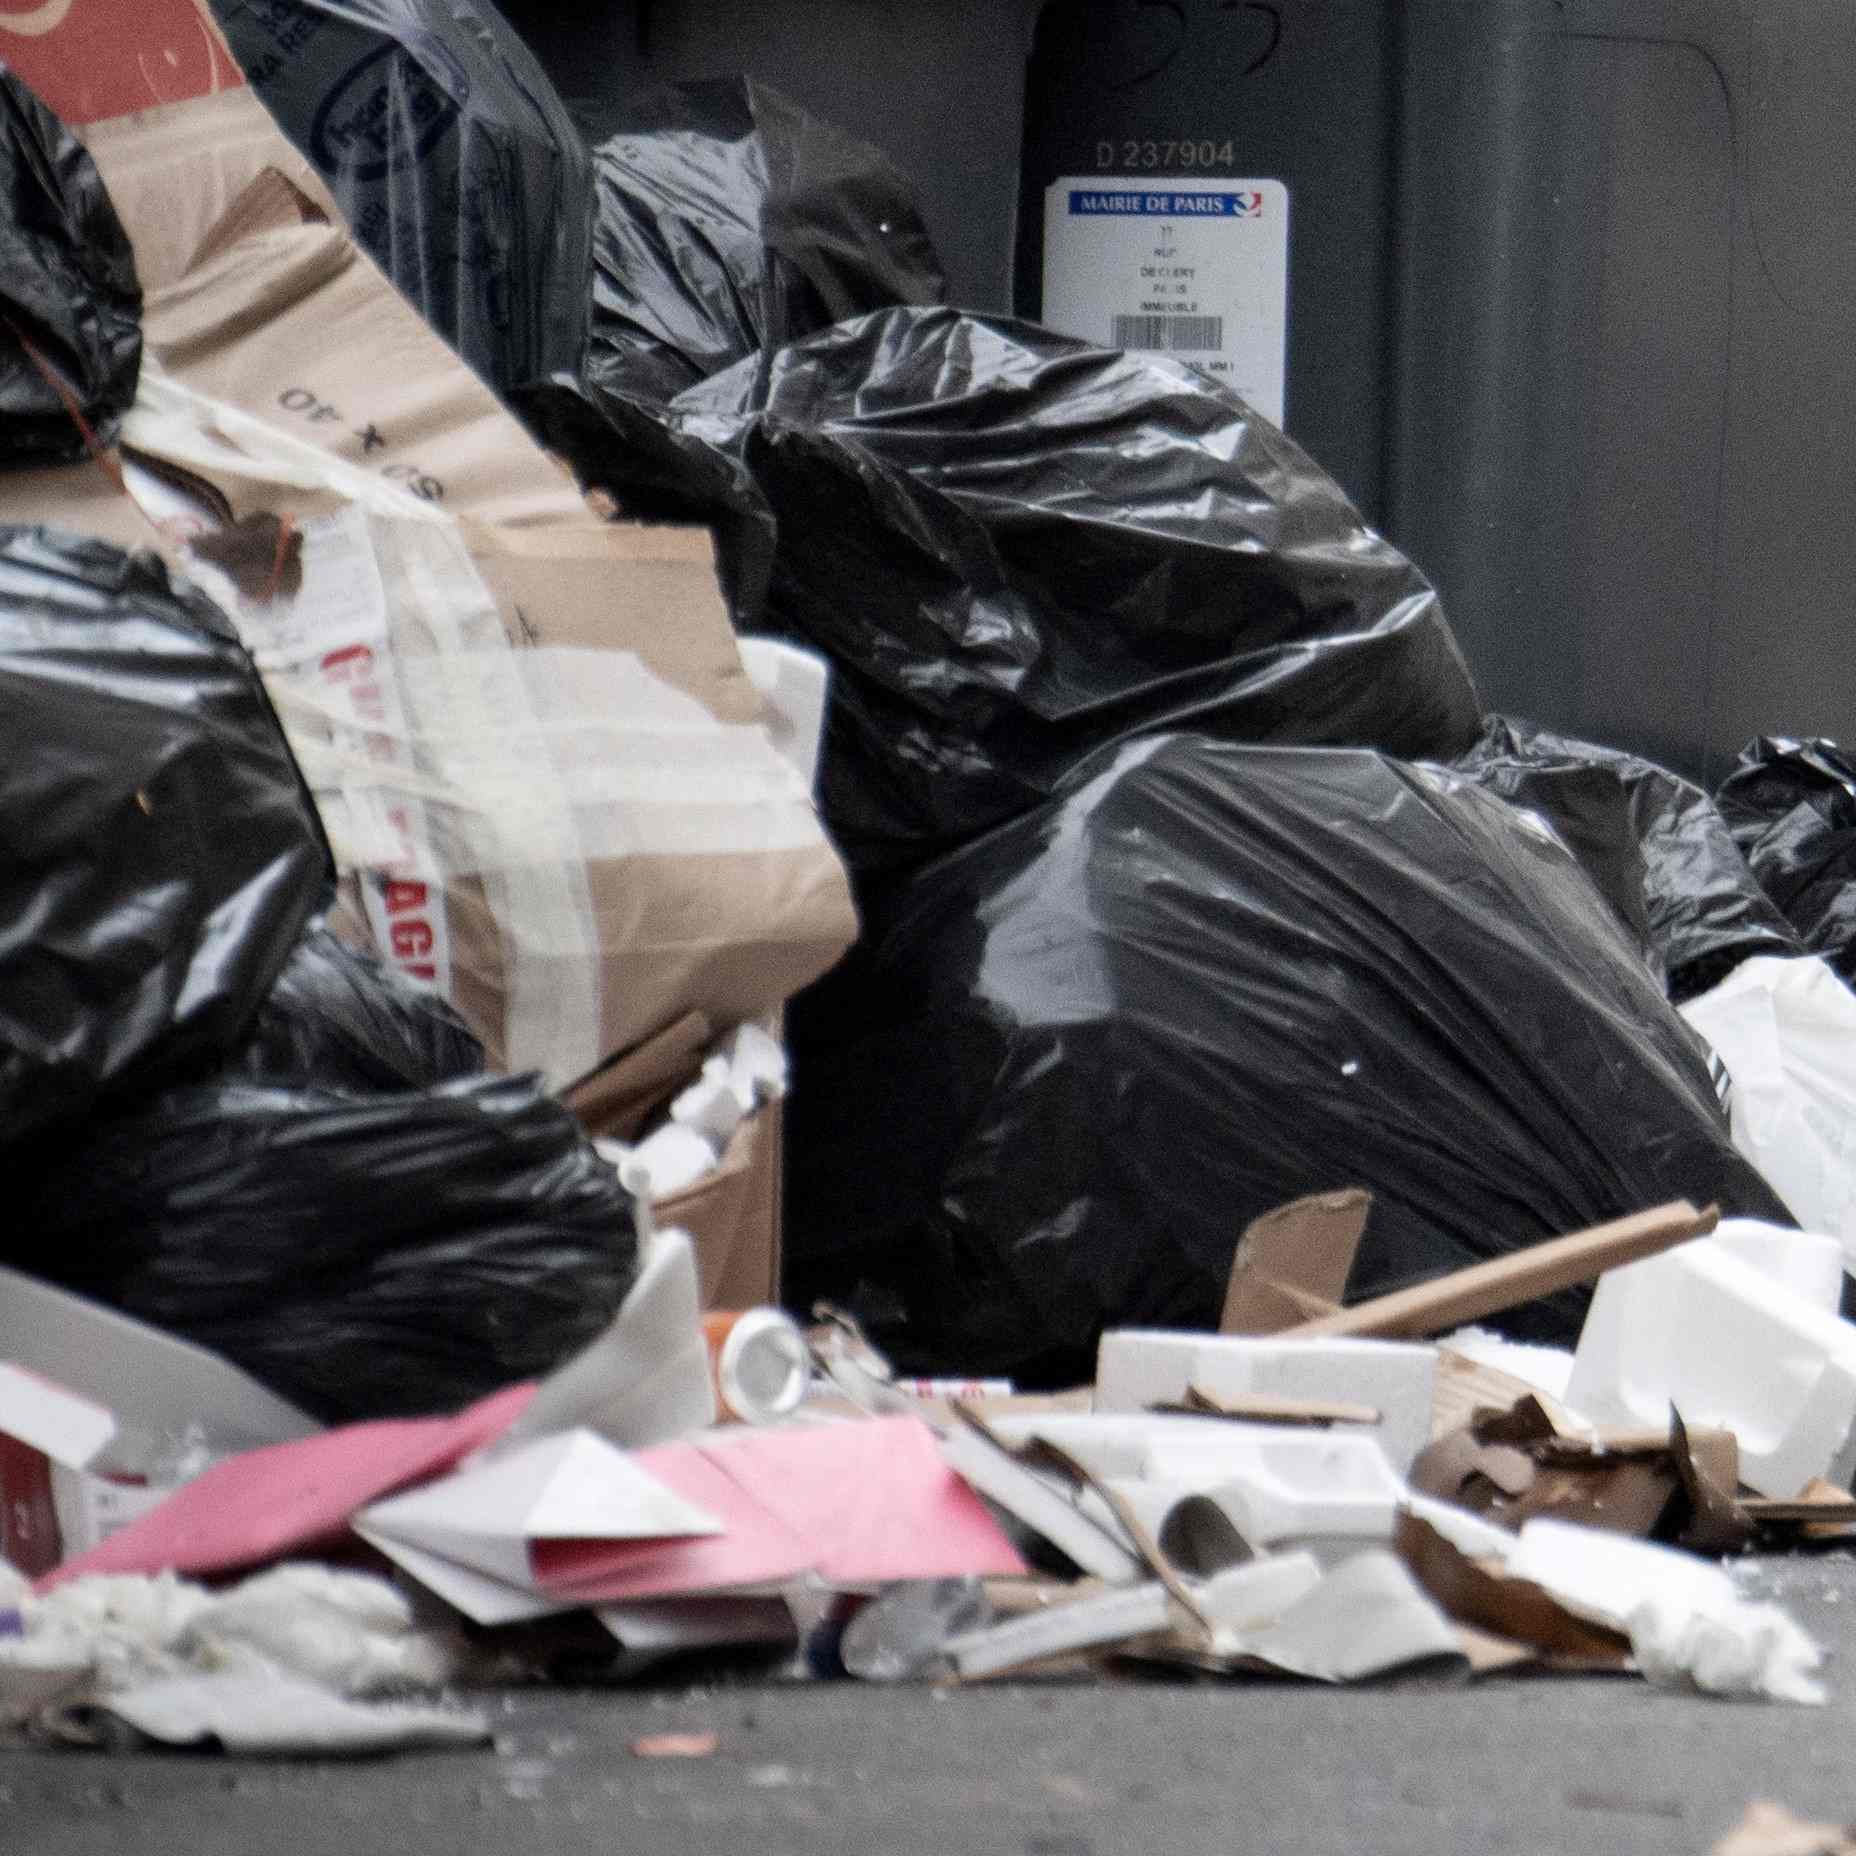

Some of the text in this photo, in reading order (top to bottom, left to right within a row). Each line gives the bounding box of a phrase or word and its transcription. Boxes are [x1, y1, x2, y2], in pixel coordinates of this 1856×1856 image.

[1096, 141, 1235, 168] D 237904
[1080, 195, 1225, 213] MAIRIE DE PARIS
[1152, 283, 1188, 296] PAIS
